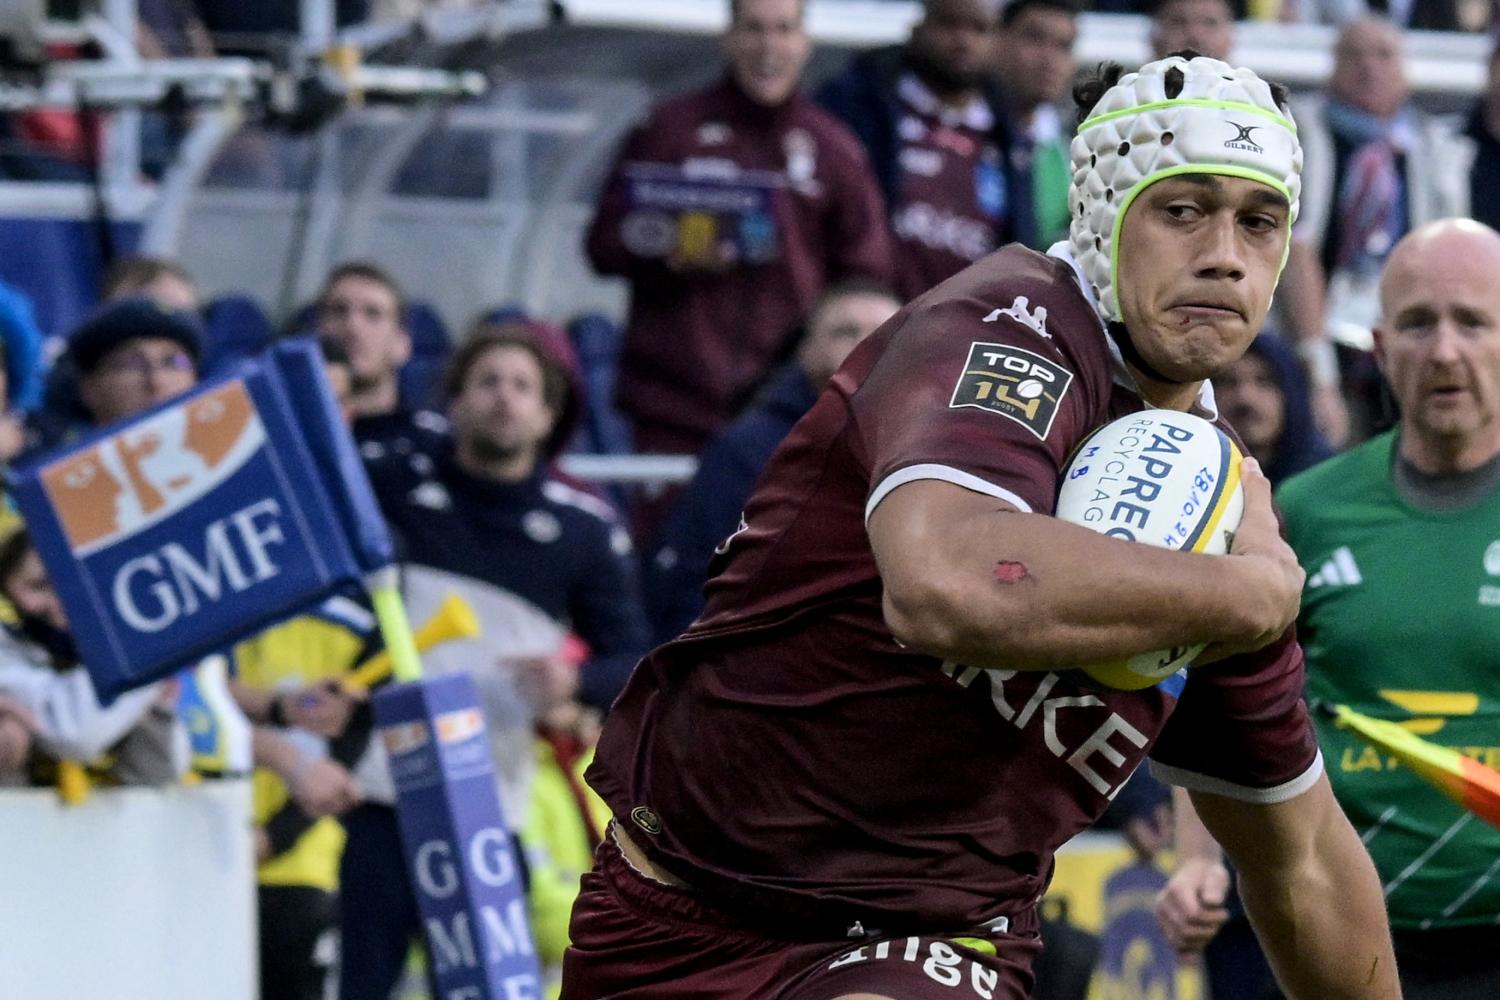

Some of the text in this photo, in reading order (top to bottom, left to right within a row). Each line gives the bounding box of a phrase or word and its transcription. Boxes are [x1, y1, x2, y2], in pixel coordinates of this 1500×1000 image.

[1223, 141, 1264, 154] GILBERT
[982, 352, 1056, 383] TOP
[975, 381, 1041, 421] 14
[113, 498, 286, 634] GMF
[1340, 745, 1383, 772] LA
